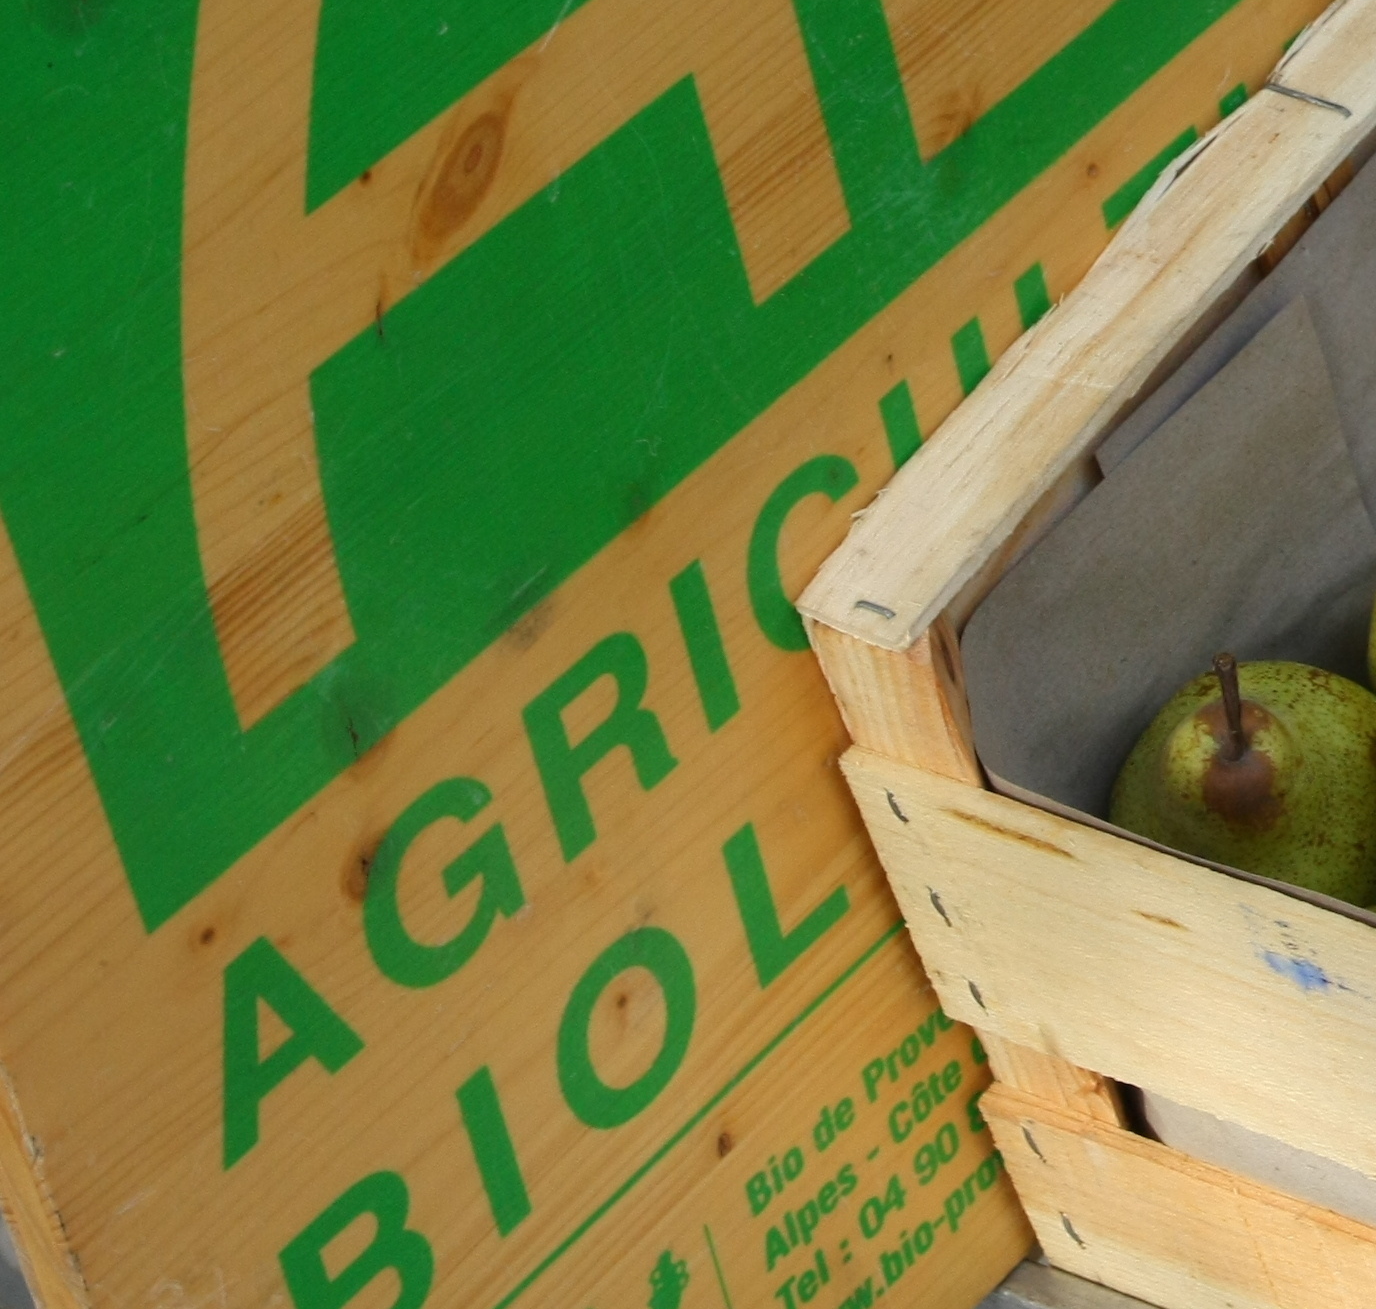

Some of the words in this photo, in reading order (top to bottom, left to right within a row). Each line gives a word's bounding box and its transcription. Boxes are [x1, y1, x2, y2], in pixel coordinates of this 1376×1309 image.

[745, 1146, 805, 1218] Bio
[812, 1096, 856, 1153] de
[764, 1163, 858, 1273] Alpes
[887, 1059, 963, 1144] Côte
[774, 1248, 831, 1309] Tel
[858, 1172, 908, 1240] 04
[913, 1122, 960, 1186] 90
